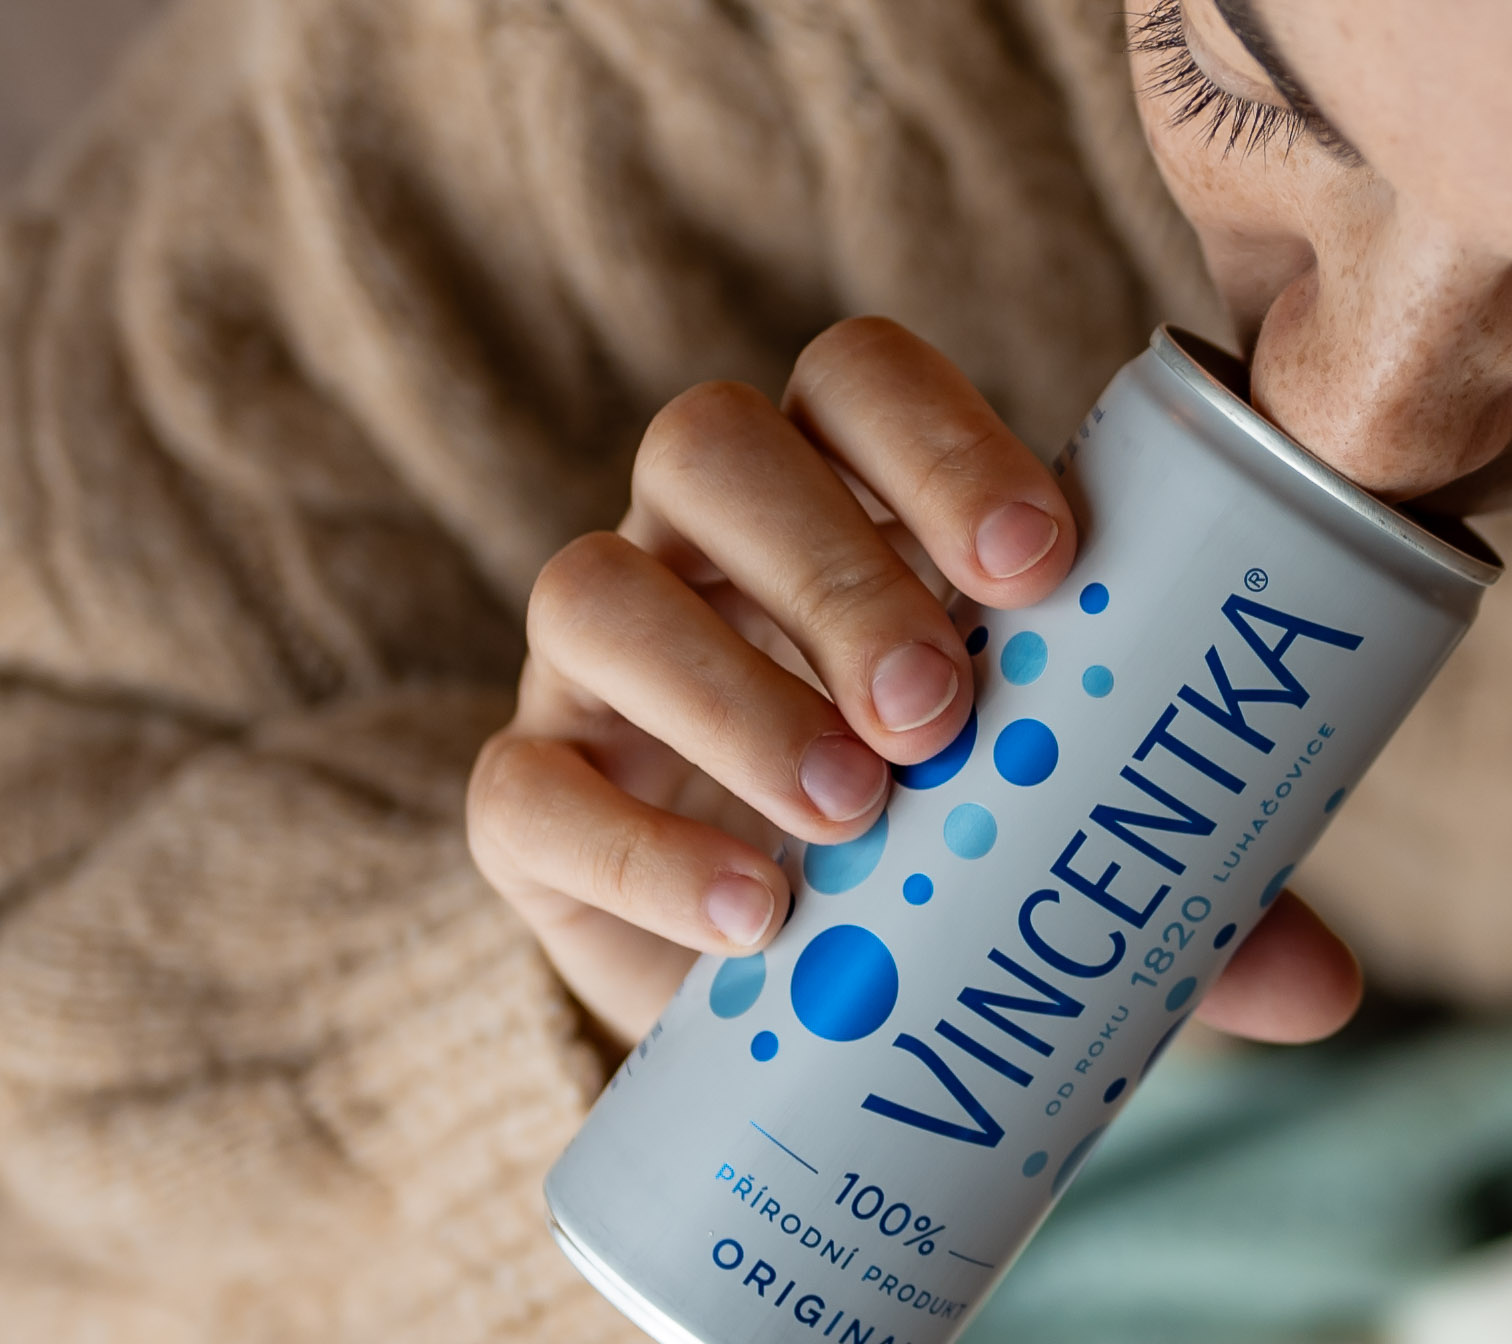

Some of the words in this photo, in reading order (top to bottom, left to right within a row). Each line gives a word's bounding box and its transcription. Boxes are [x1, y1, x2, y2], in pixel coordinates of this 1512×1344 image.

[1045, 1080, 1075, 1117] OD
[1074, 1004, 1130, 1076] ROKU
[1130, 895, 1213, 988] 1820
[1212, 722, 1336, 884] LUHAČOVICE
[714, 1162, 860, 1270] PŘÍRODNÍ
[861, 1264, 968, 1322] PRODUKT
[834, 1172, 946, 1256] 100%
